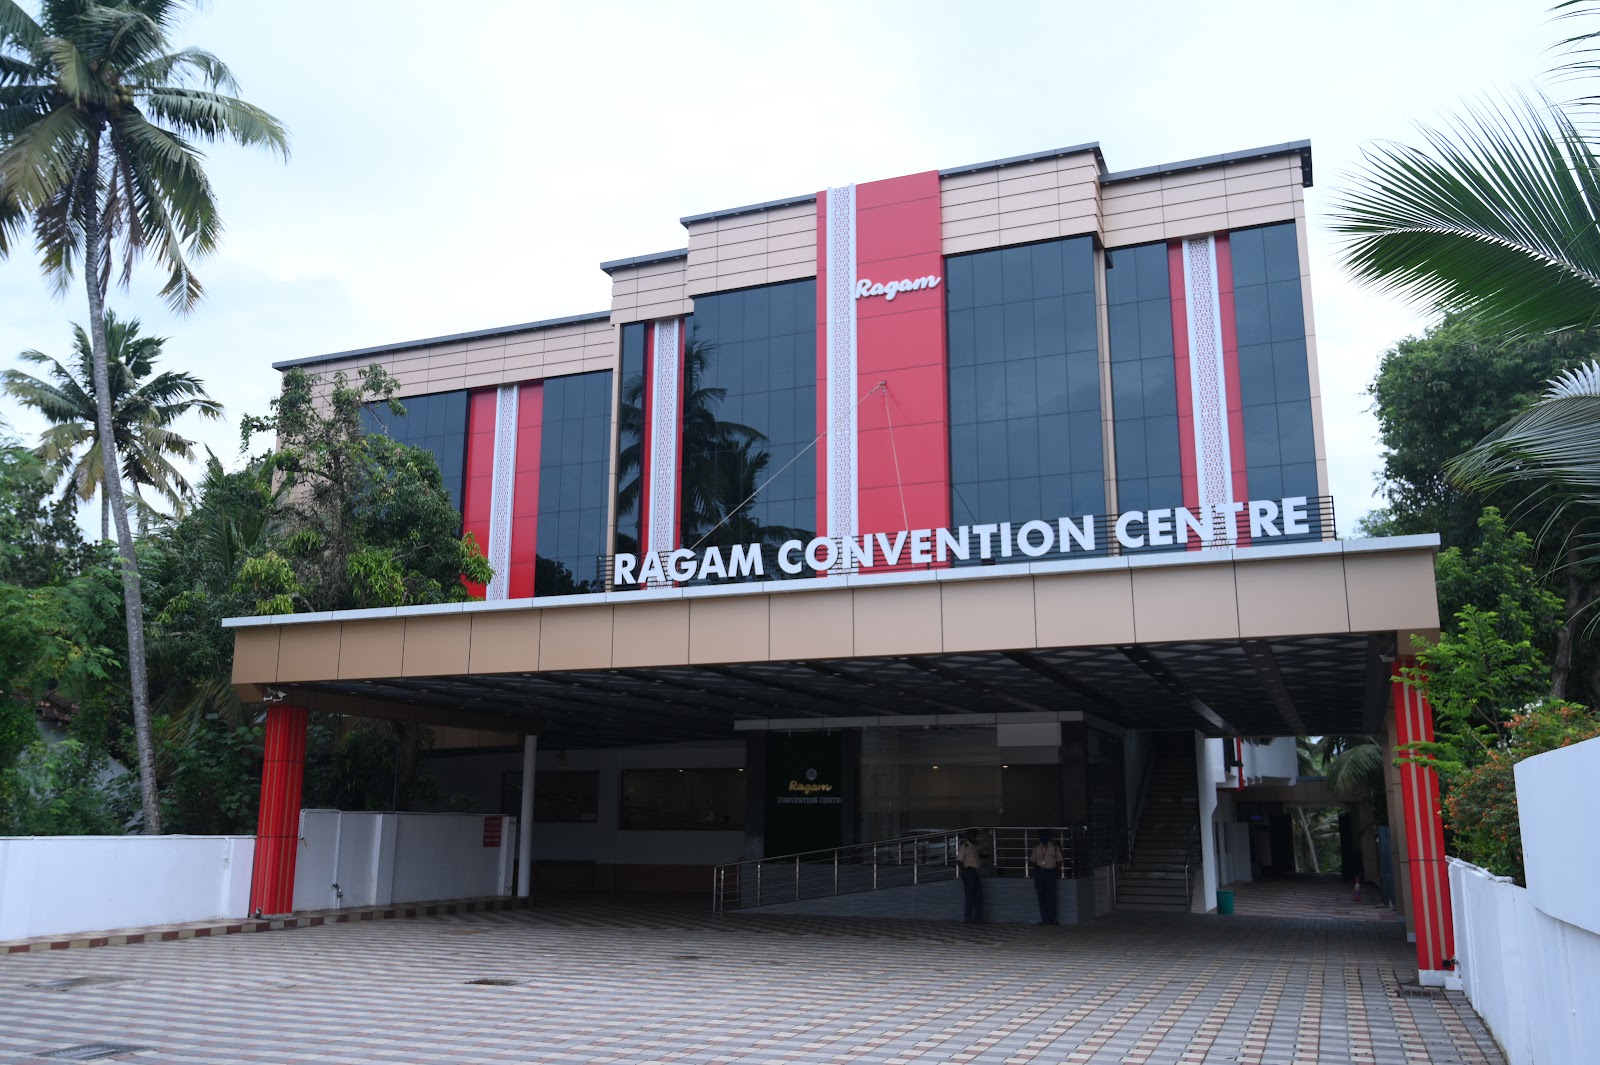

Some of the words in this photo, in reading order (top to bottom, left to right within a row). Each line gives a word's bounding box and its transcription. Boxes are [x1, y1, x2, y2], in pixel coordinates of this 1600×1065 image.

[855, 275, 941, 300] Ragam
[614, 543, 764, 585] RAGAM
[777, 515, 1095, 574] CONVENTION
[1115, 496, 1310, 548] CENTRE
[789, 780, 832, 794] Ragam
